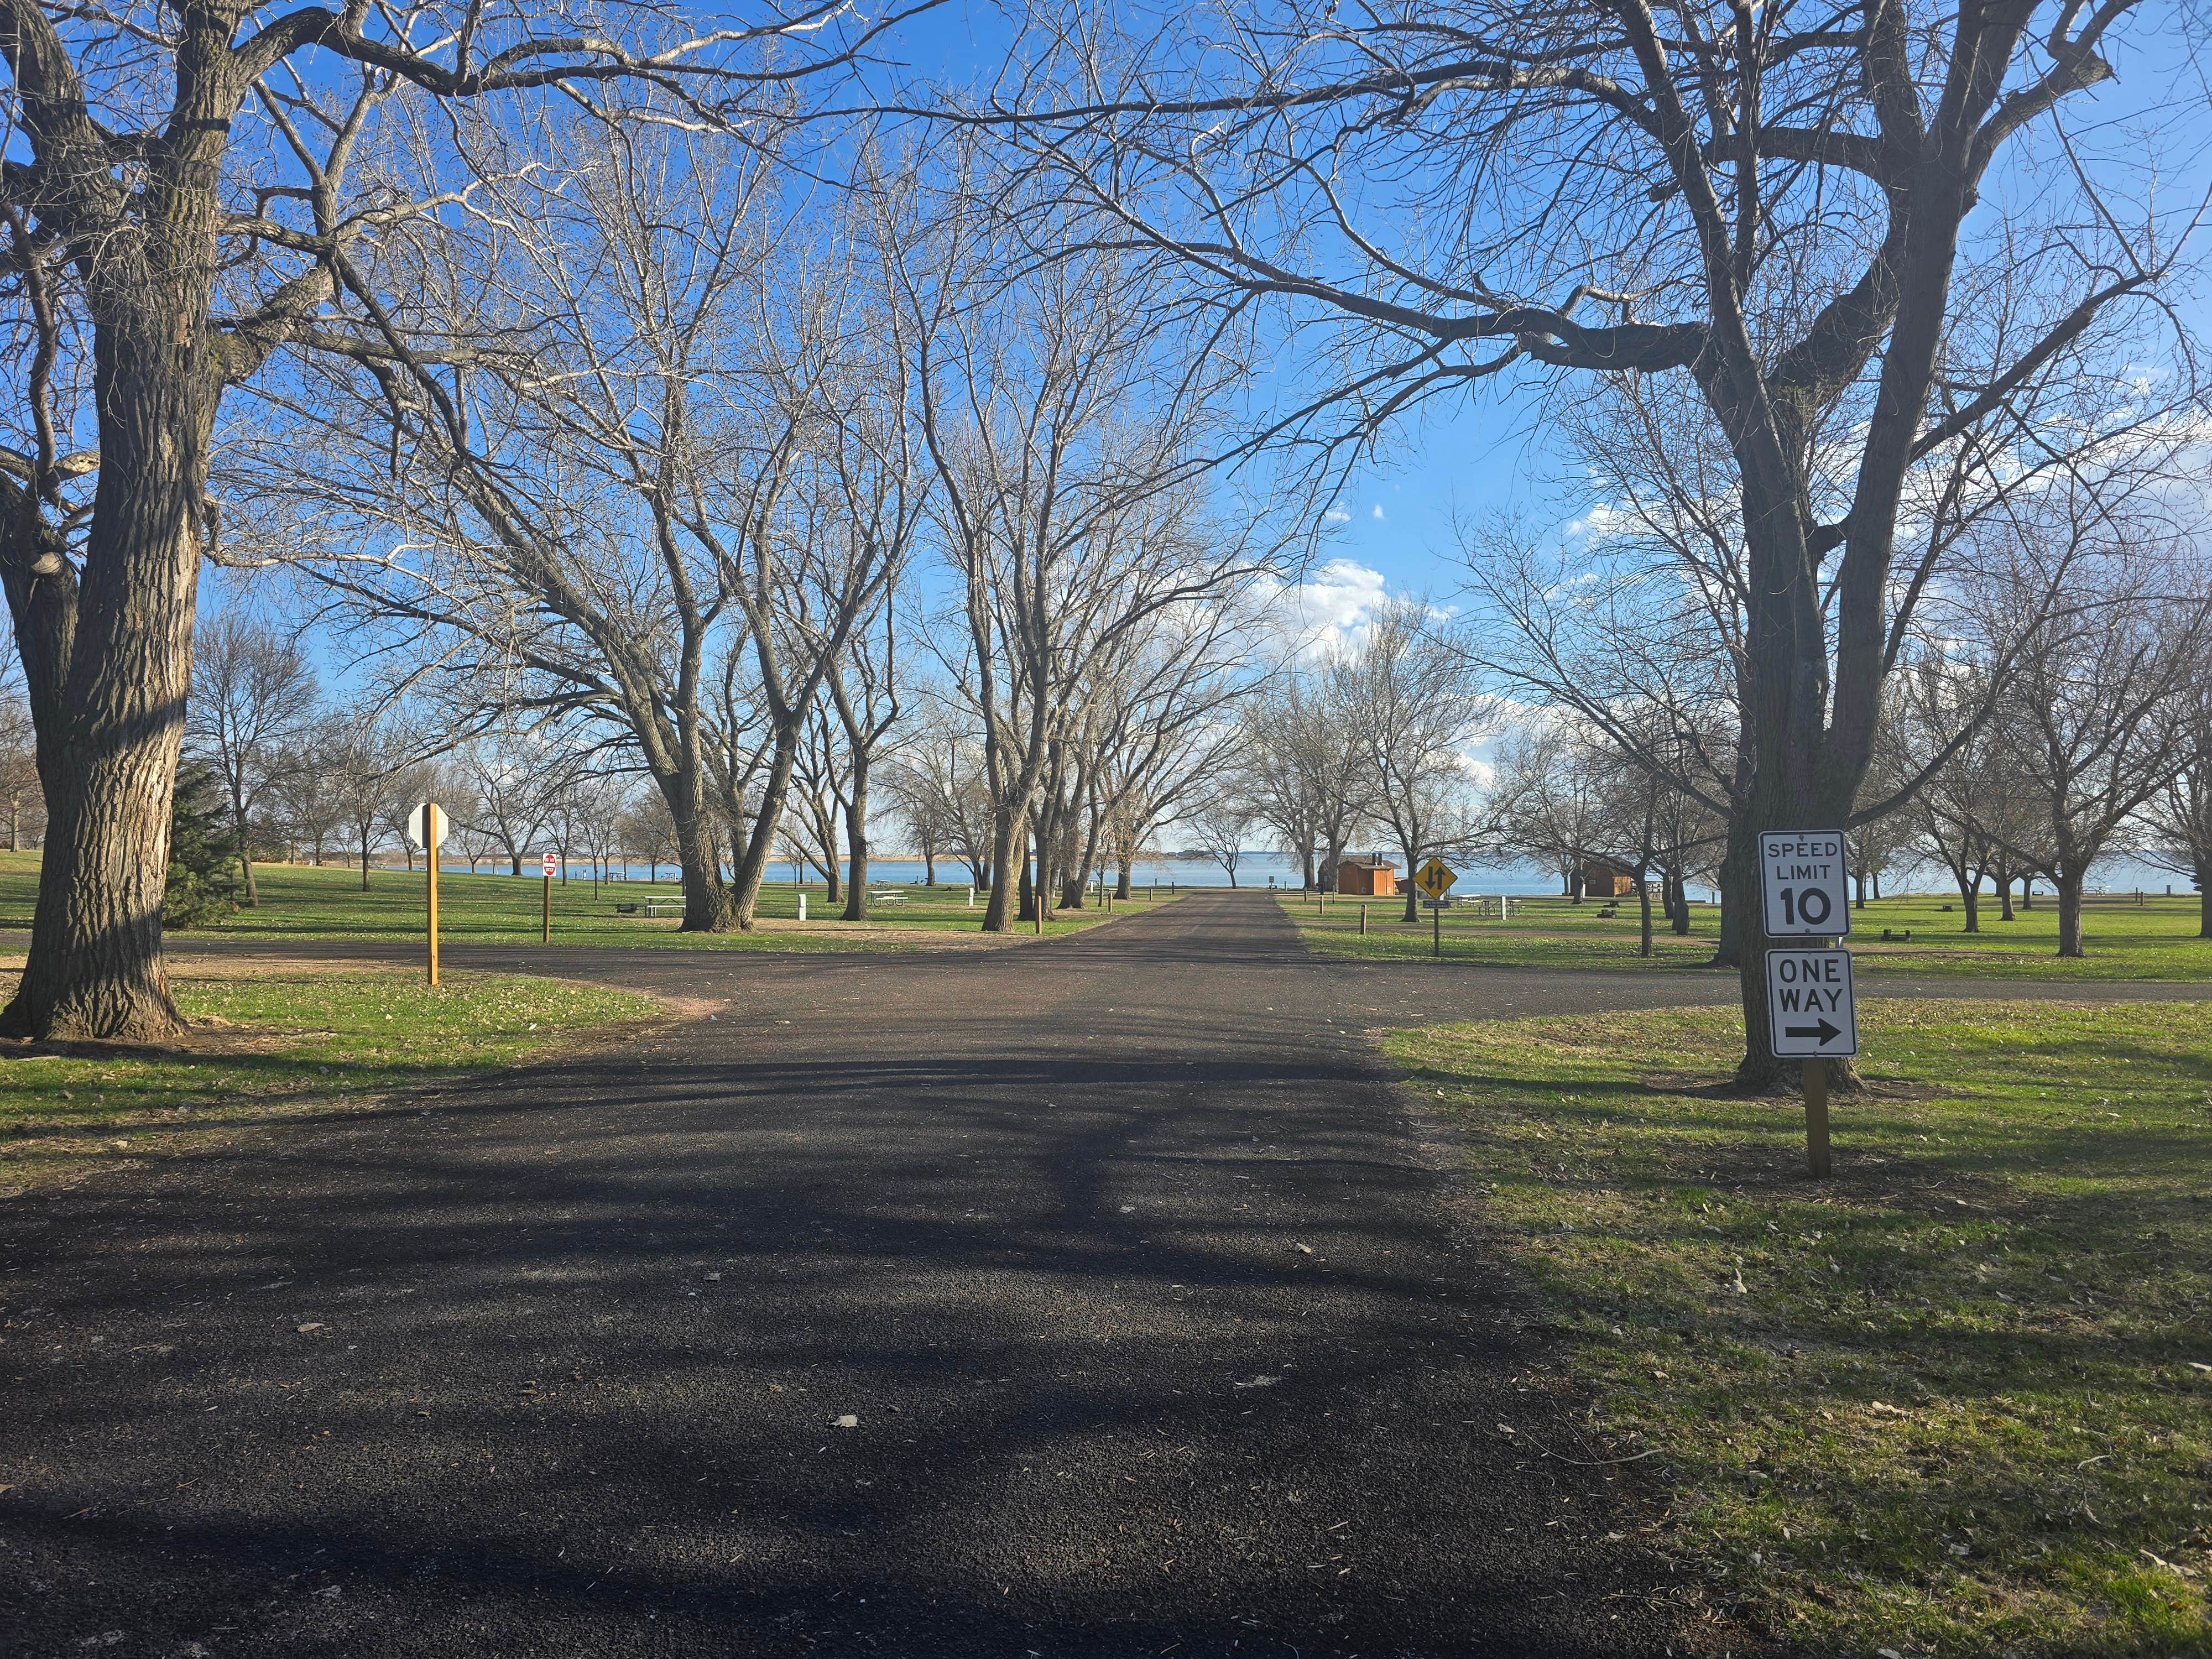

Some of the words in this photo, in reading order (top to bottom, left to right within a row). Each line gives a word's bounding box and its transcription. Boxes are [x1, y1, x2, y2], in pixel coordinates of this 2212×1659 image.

[1768, 842, 1838, 857] SPEED
[1777, 865, 1830, 879] LIMIT
[1780, 888, 1831, 925] 10
[1780, 959, 1840, 983] ONE
[1779, 989, 1843, 1012] WAY
